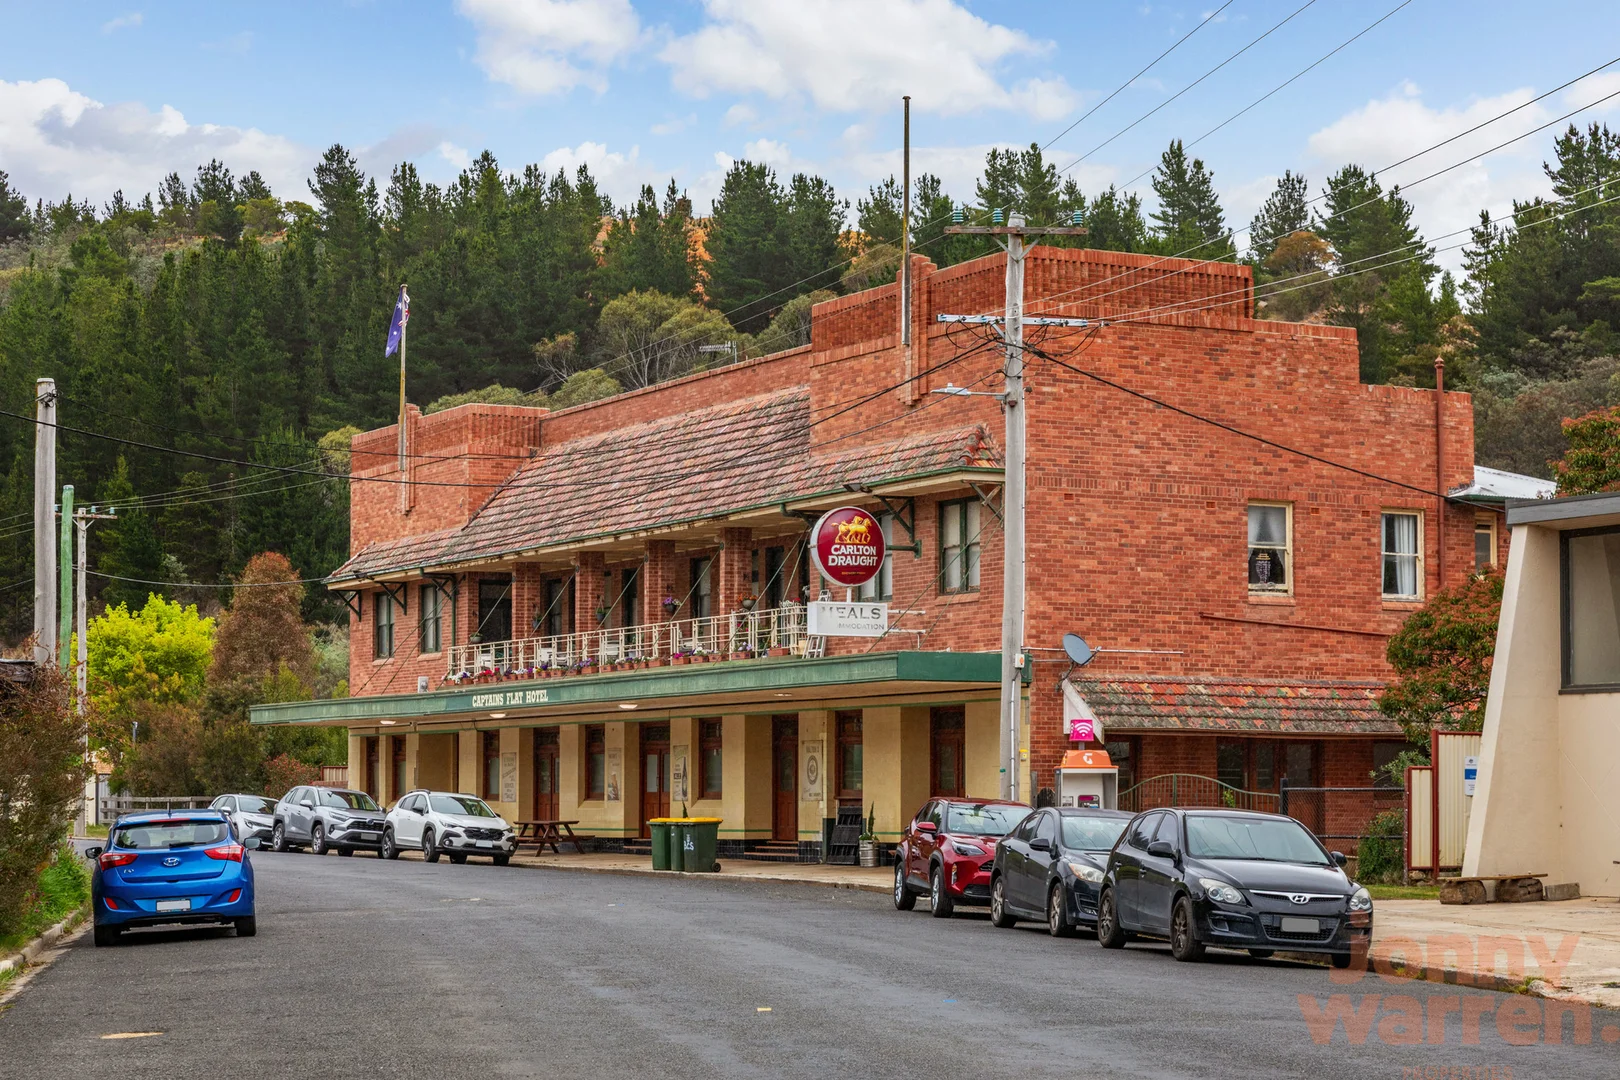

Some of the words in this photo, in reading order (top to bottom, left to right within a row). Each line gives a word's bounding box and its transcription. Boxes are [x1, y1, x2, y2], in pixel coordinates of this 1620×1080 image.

[832, 545, 876, 555] CARLTON
[828, 556, 877, 566] DRAUGHT
[472, 694, 503, 707] CAPTAINS
[506, 692, 523, 704] FLAT
[526, 690, 548, 703] HOTEL
